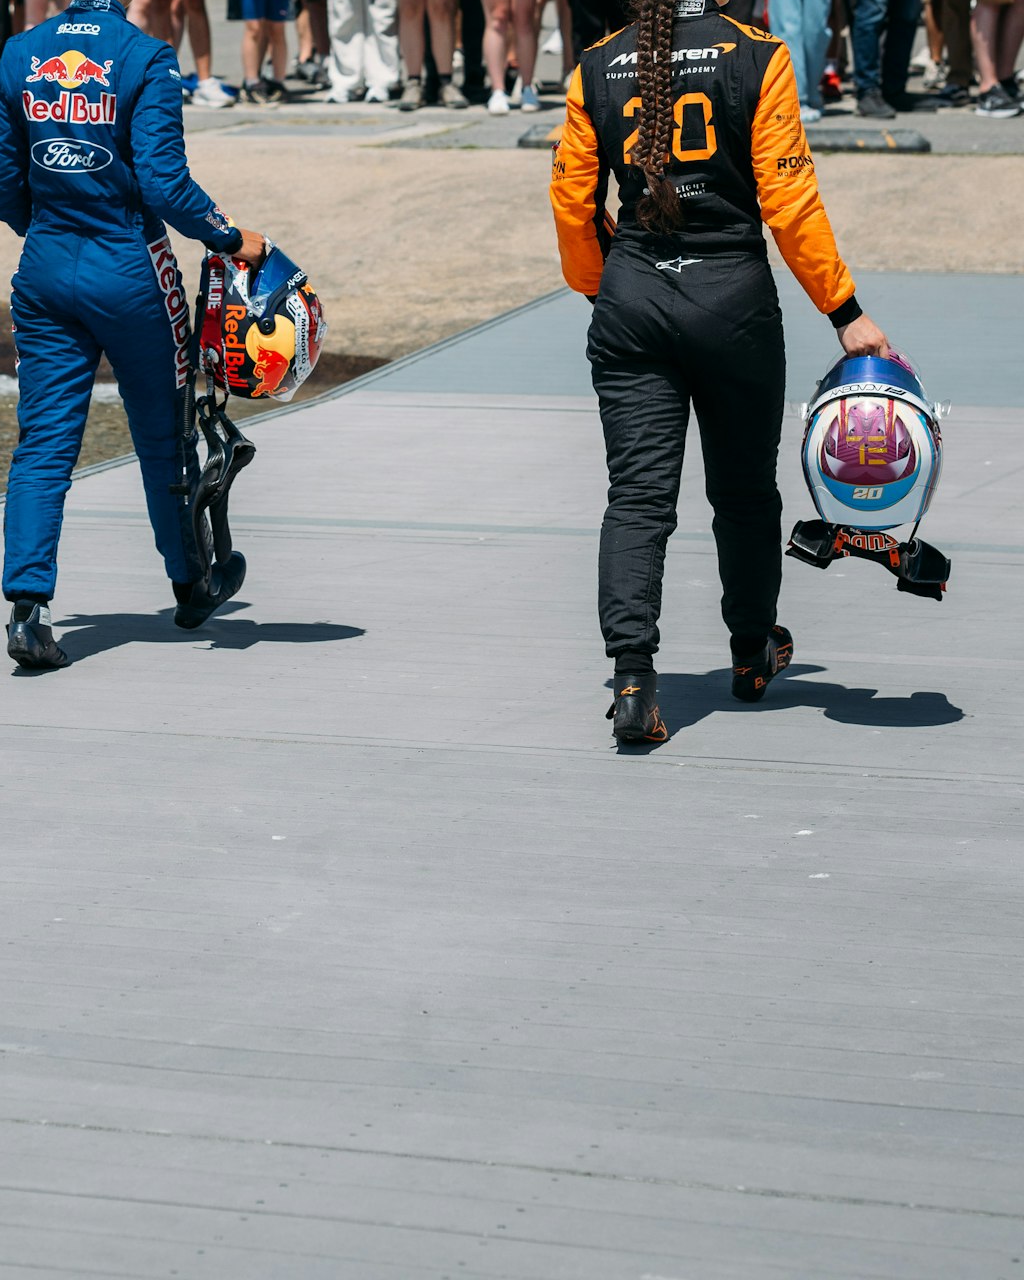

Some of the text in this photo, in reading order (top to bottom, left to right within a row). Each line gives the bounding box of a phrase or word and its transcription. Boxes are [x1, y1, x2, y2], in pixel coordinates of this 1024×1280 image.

[679, 66, 716, 76] ACADEMY
[23, 91, 116, 125] Red Bull
[43, 137, 95, 167] Ford
[675, 183, 706, 194] LIGHT
[207, 267, 223, 310] CHLOE
[224, 304, 247, 349] Red
[225, 352, 249, 388] Bull
[853, 487, 884, 500] 20
